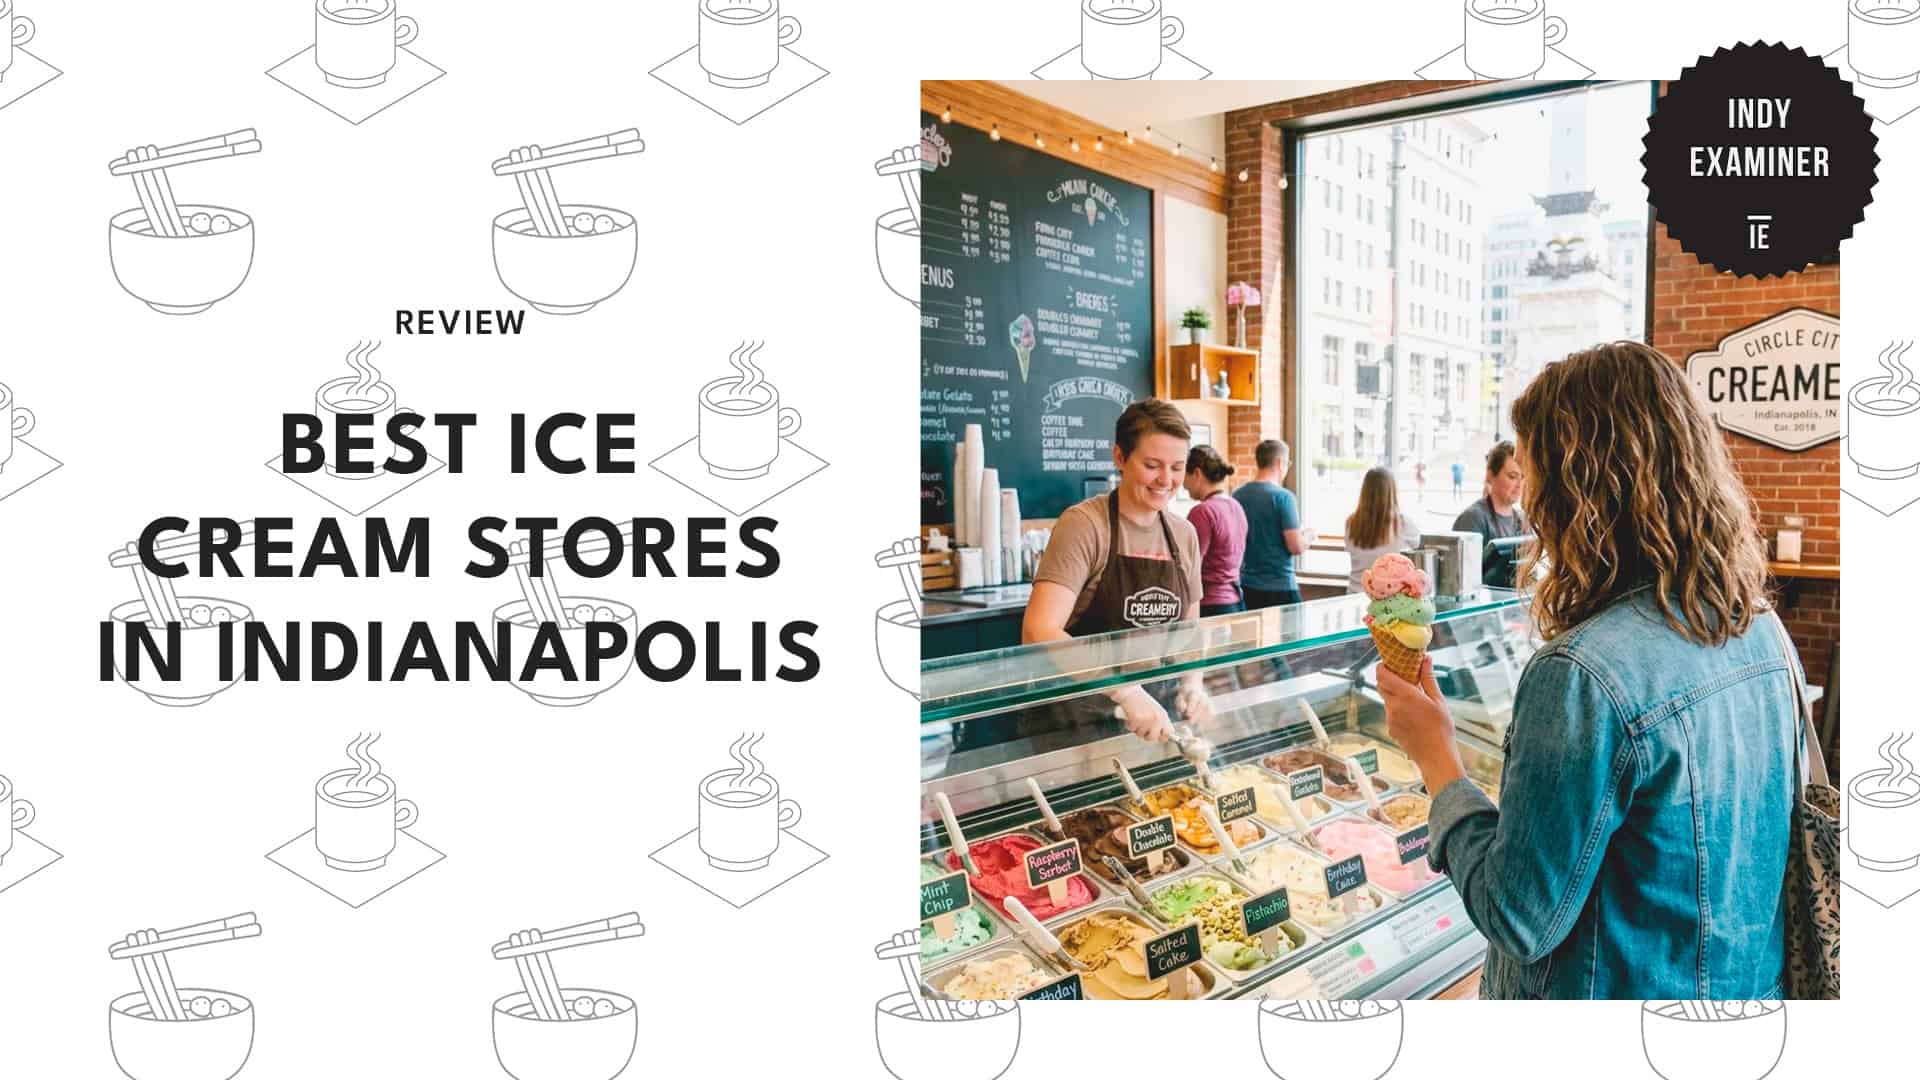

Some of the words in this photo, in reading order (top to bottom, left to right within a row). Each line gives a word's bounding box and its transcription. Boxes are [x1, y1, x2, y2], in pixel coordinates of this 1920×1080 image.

[1743, 328, 1804, 358] CIRCLE
[1708, 363, 1840, 402] CREAME
[1754, 409, 1822, 421] Indianapolis,
[1825, 409, 1837, 417] IN
[1774, 423, 1789, 432] Est.
[1794, 423, 1816, 432] 2018
[1130, 602, 1178, 617] CREAMERY
[1028, 847, 1077, 869] Raspberry
[1039, 860, 1072, 880] Sorbet
[920, 880, 950, 901] Mint
[924, 898, 953, 914] Chip
[1150, 932, 1188, 959] Salted
[1158, 951, 1190, 971] Cake
